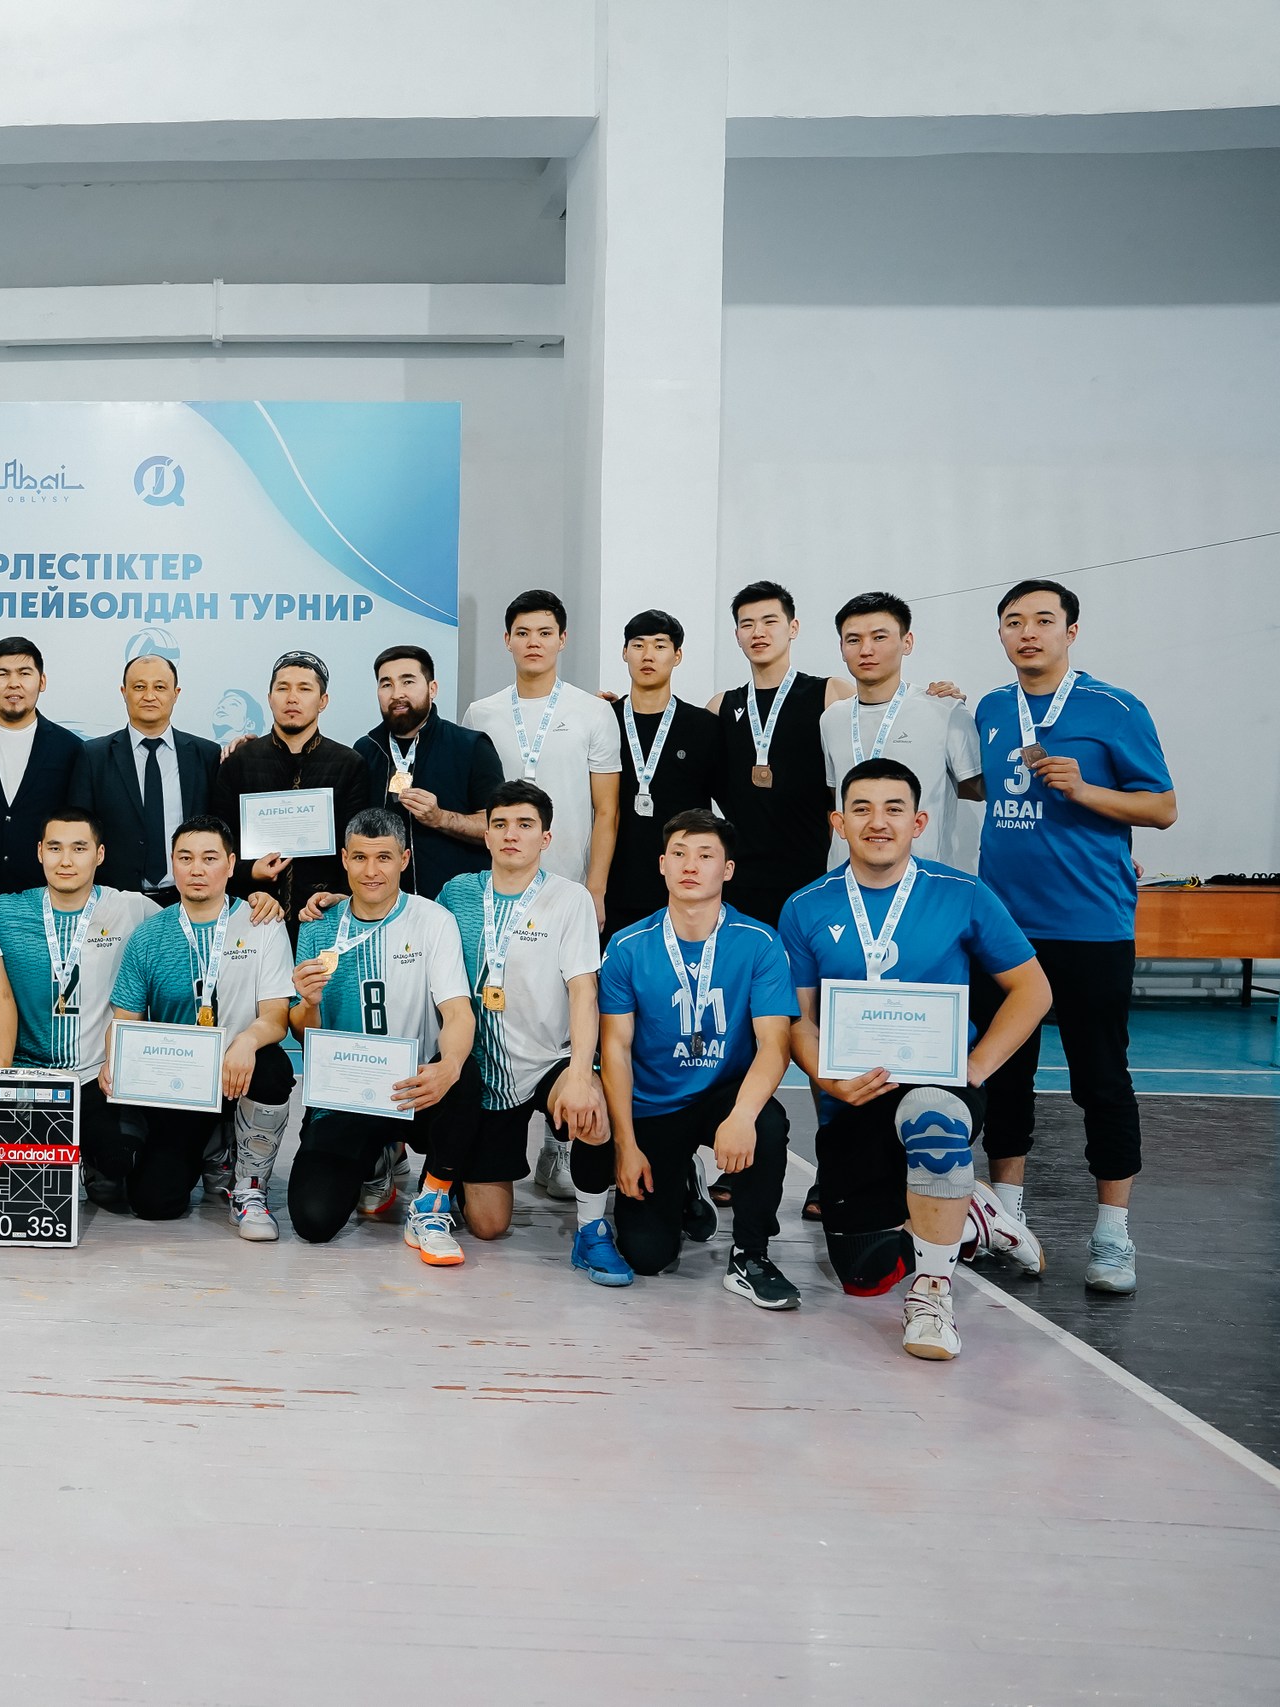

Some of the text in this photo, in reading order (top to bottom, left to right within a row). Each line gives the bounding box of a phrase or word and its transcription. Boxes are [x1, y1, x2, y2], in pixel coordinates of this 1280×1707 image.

[229, 593, 374, 622] ТУРНИР
[1003, 747, 1031, 795] 3
[258, 805, 315, 816] АЛҒЫС ХАТ
[993, 800, 1043, 819] ABAI
[995, 820, 1036, 829] AUDANY
[361, 979, 389, 1036] 8
[671, 987, 727, 1036] 11
[861, 1009, 926, 1022] ДИПЛОМ
[143, 1045, 194, 1058] ДИПЛОМ
[333, 1051, 388, 1065] ДИПЛОМ
[679, 1058, 719, 1069] AUDANY
[7, 1147, 77, 1162] android TV
